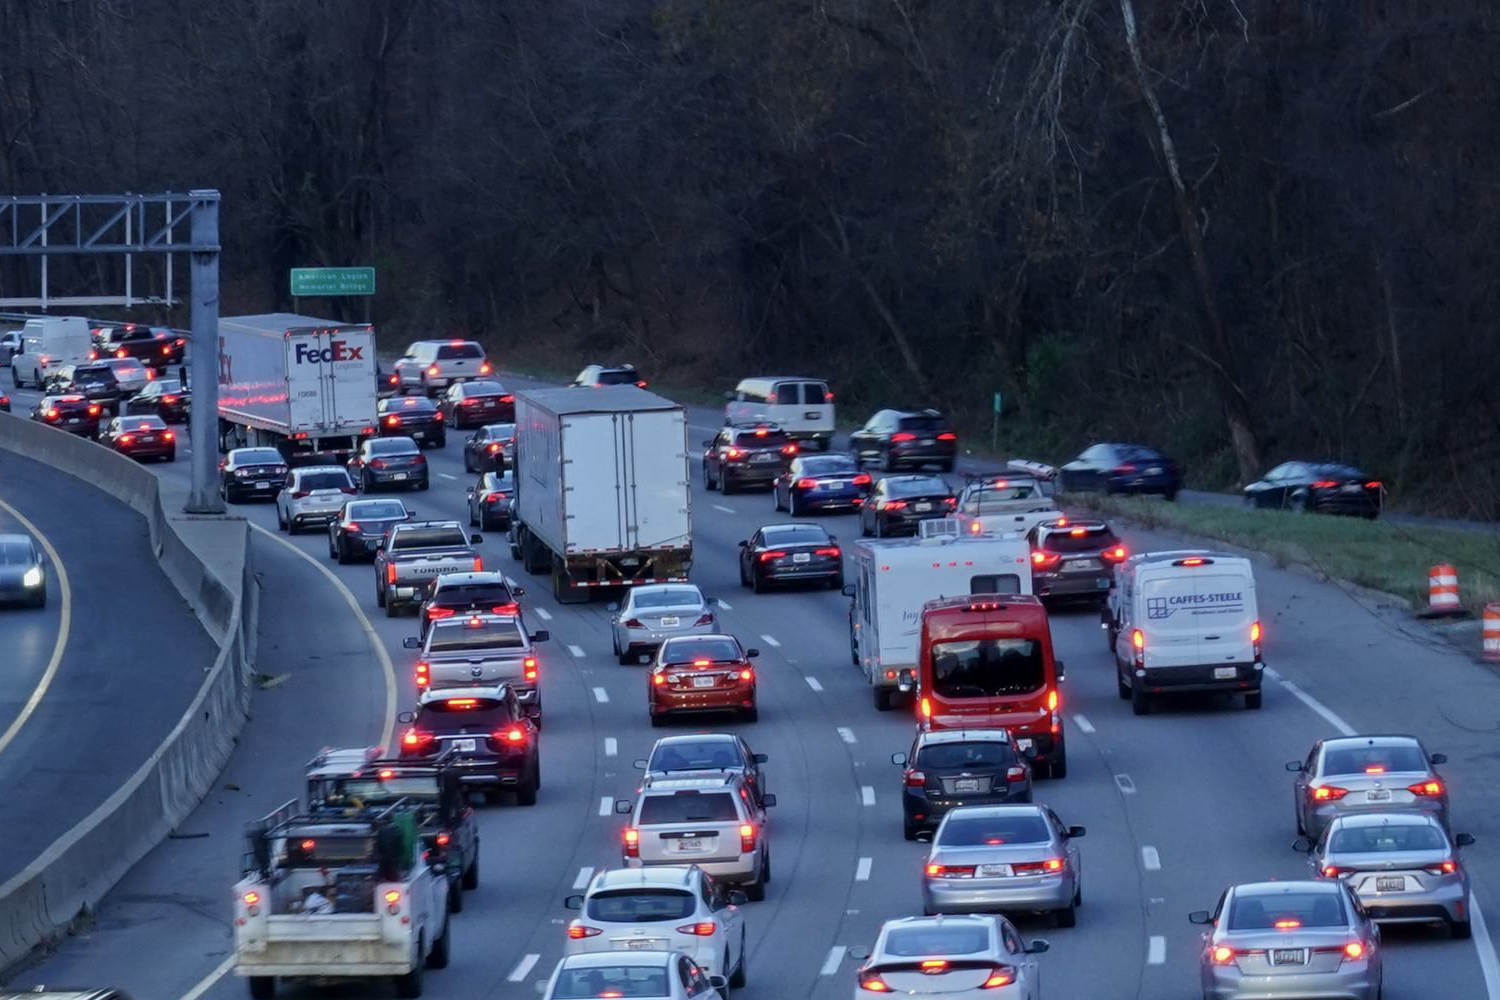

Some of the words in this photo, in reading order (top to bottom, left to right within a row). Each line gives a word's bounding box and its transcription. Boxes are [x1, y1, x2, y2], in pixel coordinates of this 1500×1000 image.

[295, 340, 364, 365] FedEx
[412, 566, 459, 574] TUNDRA
[1169, 592, 1243, 605] CAFFES-STEELE
